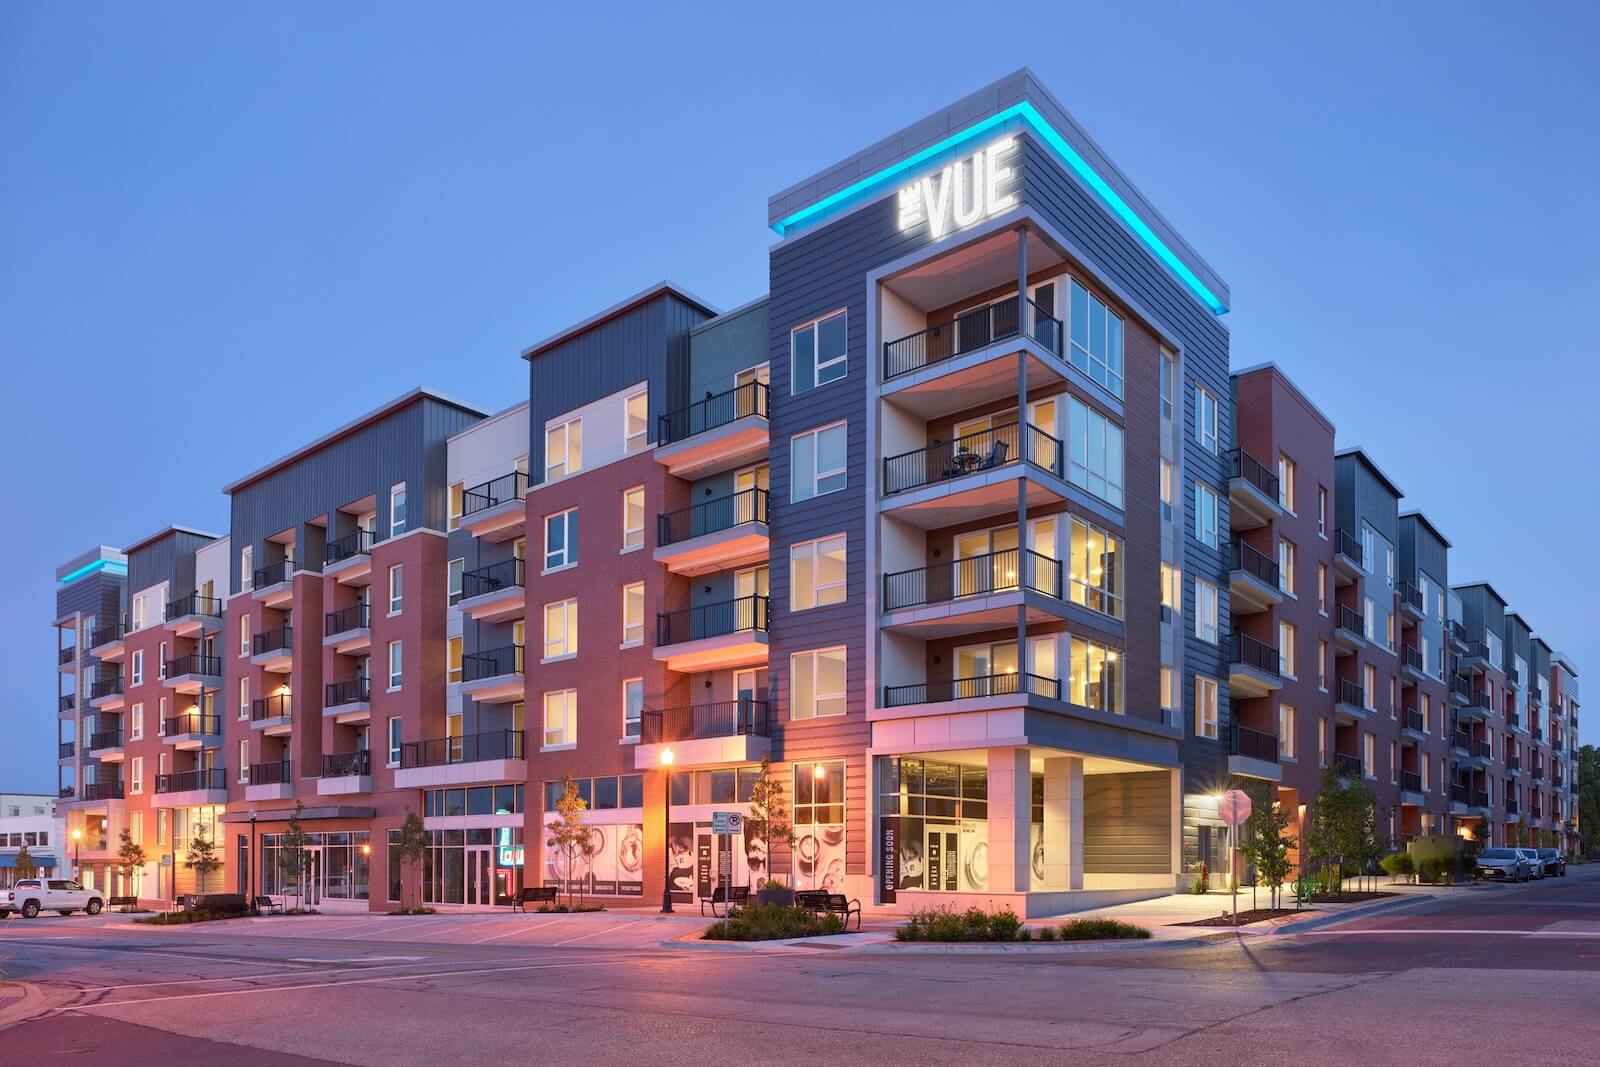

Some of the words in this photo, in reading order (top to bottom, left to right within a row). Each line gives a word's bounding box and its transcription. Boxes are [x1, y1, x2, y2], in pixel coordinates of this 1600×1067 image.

[898, 180, 922, 231] THE
[921, 136, 1014, 239] VUE
[885, 829, 894, 852] SOON
[885, 854, 894, 890] OPENING
